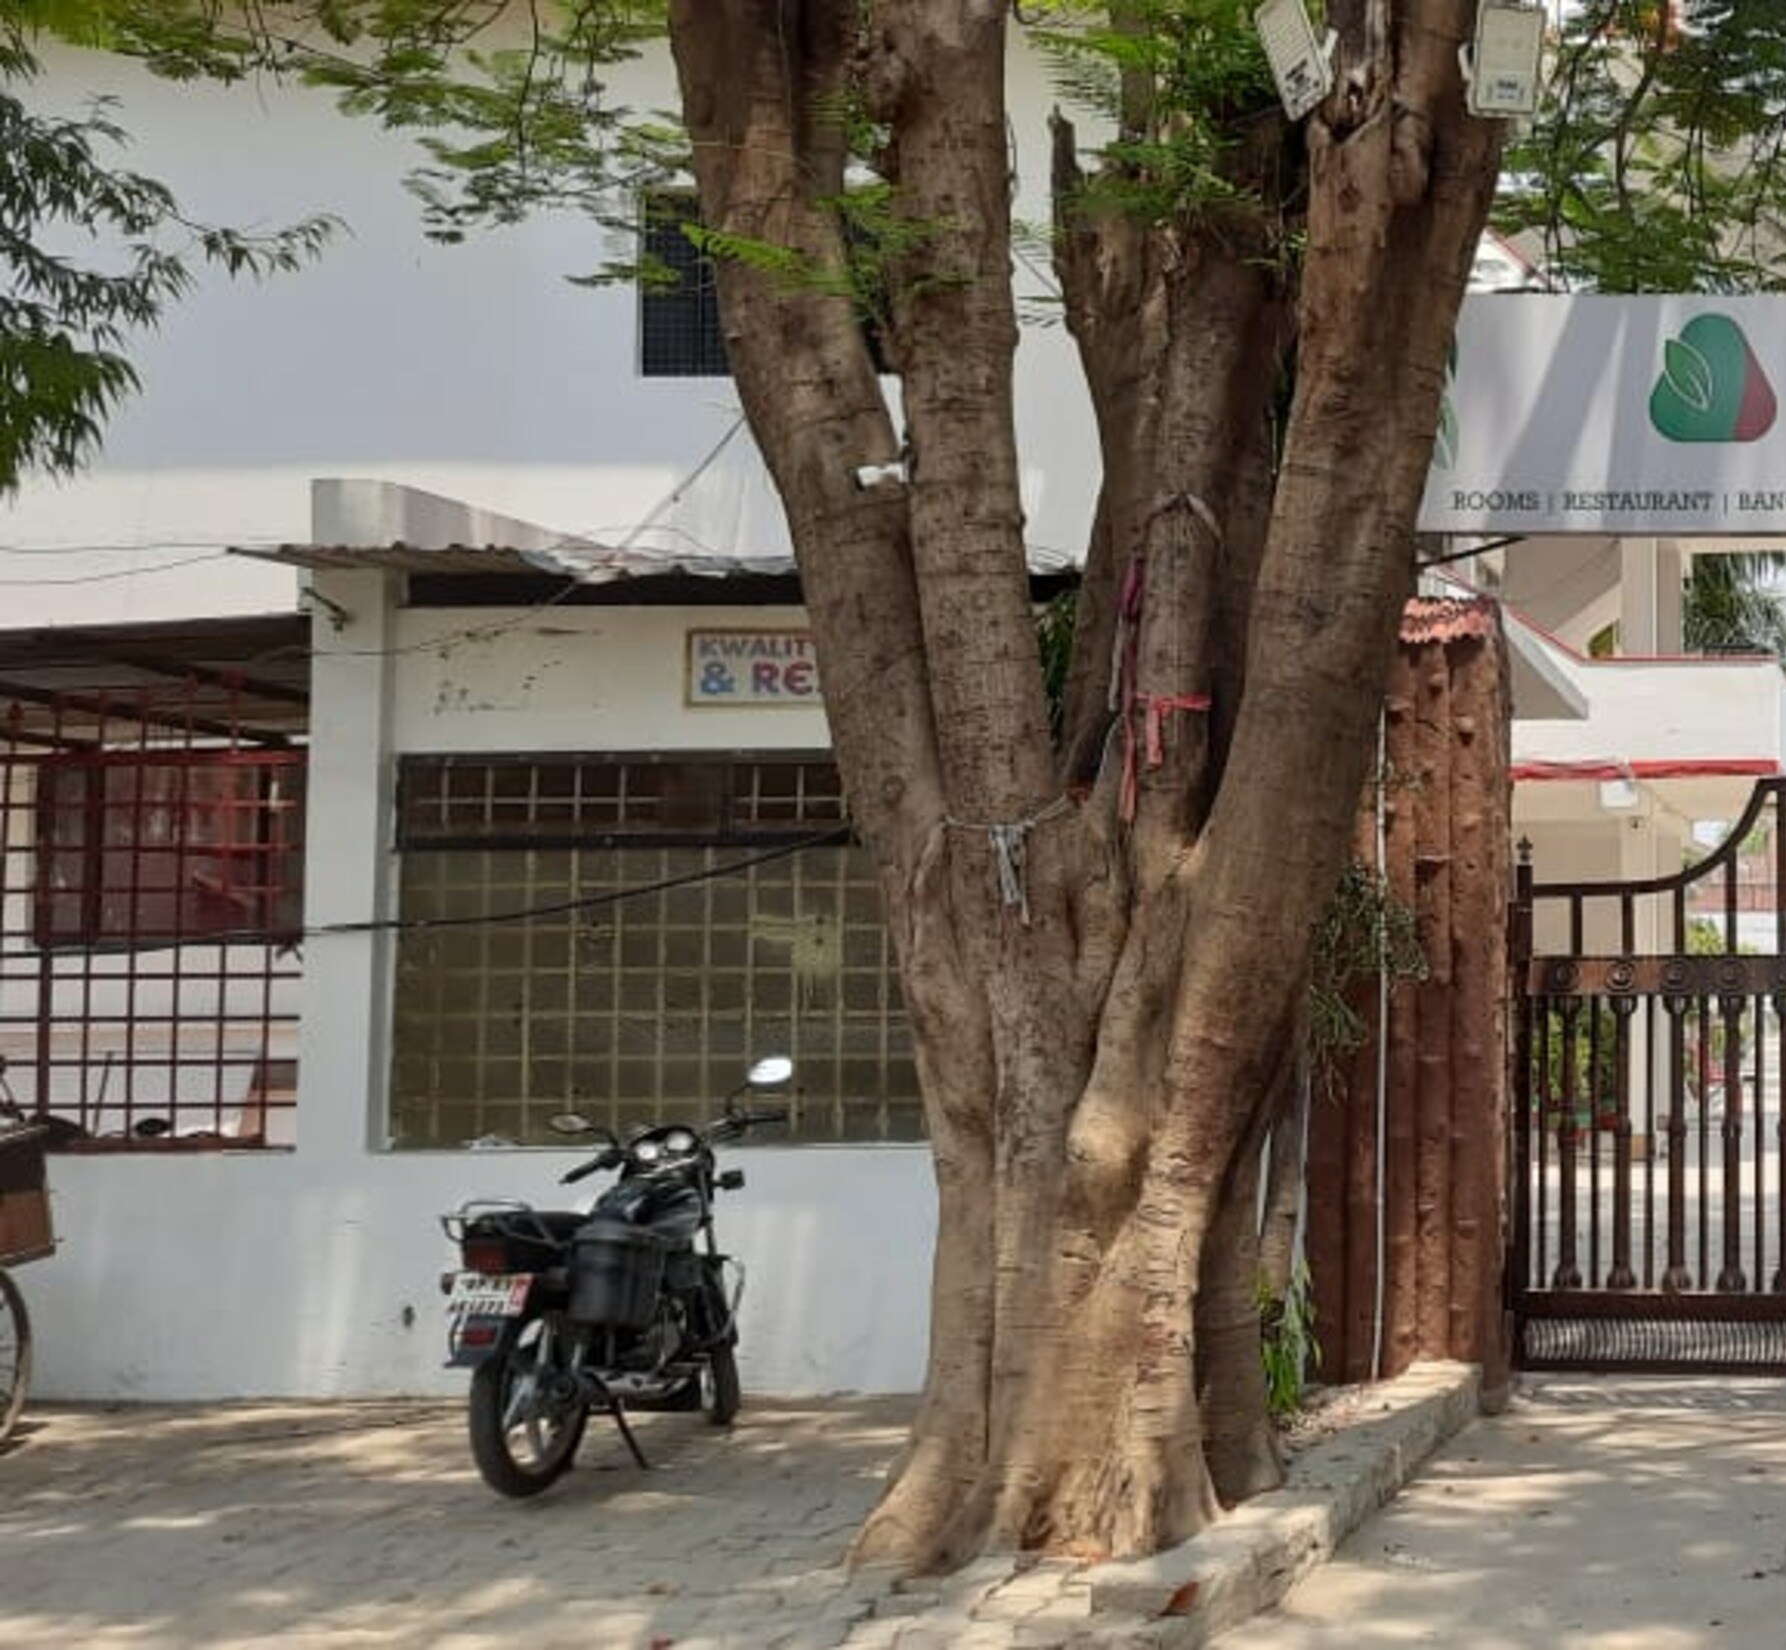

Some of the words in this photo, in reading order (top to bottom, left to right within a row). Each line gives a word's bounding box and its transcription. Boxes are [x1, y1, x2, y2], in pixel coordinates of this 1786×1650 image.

[1451, 491, 1540, 511] ROOMS
[1563, 491, 1715, 511] RESTAURANT
[699, 638, 816, 658] KWALIT
[701, 661, 735, 695] &
[753, 661, 820, 696] RE
